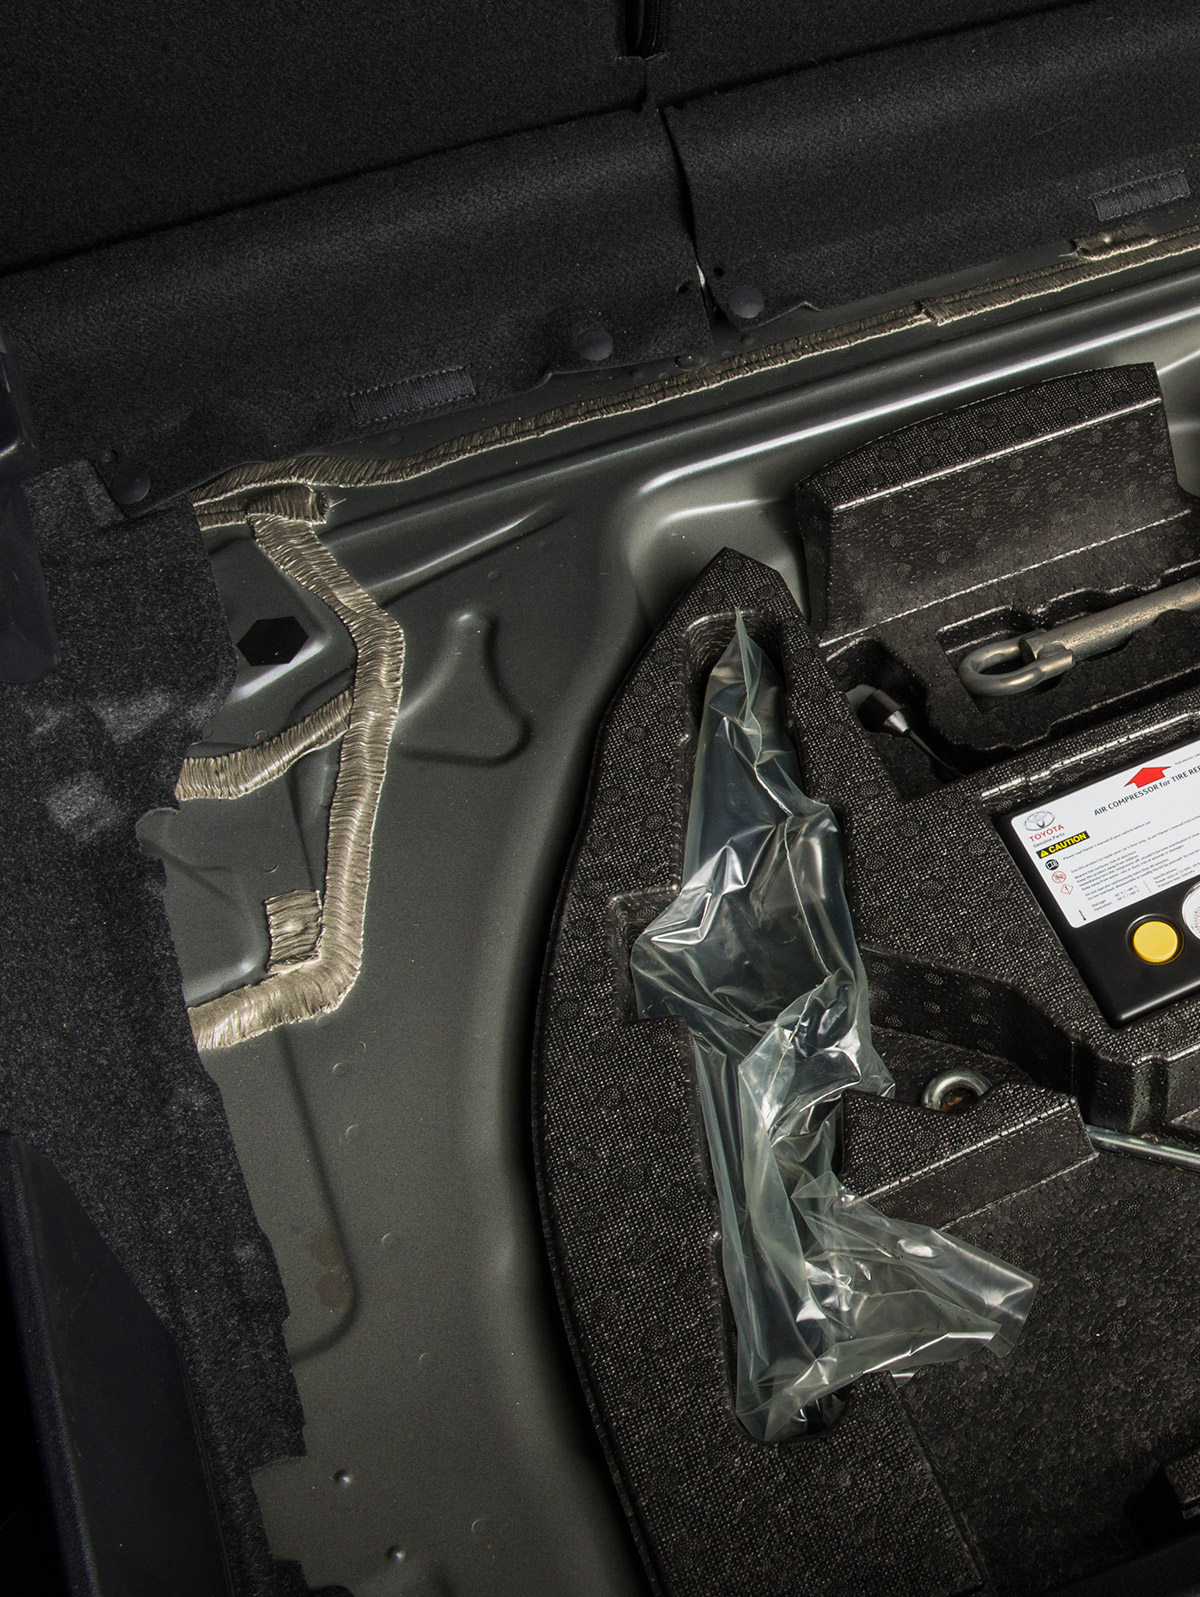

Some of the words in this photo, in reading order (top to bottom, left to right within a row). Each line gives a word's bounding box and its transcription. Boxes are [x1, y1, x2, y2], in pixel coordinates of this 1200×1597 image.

[1094, 806, 1107, 816] AIR
[1108, 784, 1159, 810] COMPRESSOR
[1171, 772, 1188, 782] TIRE
[1029, 824, 1064, 842] TOYOTA
[1048, 832, 1087, 853] CAUTION
